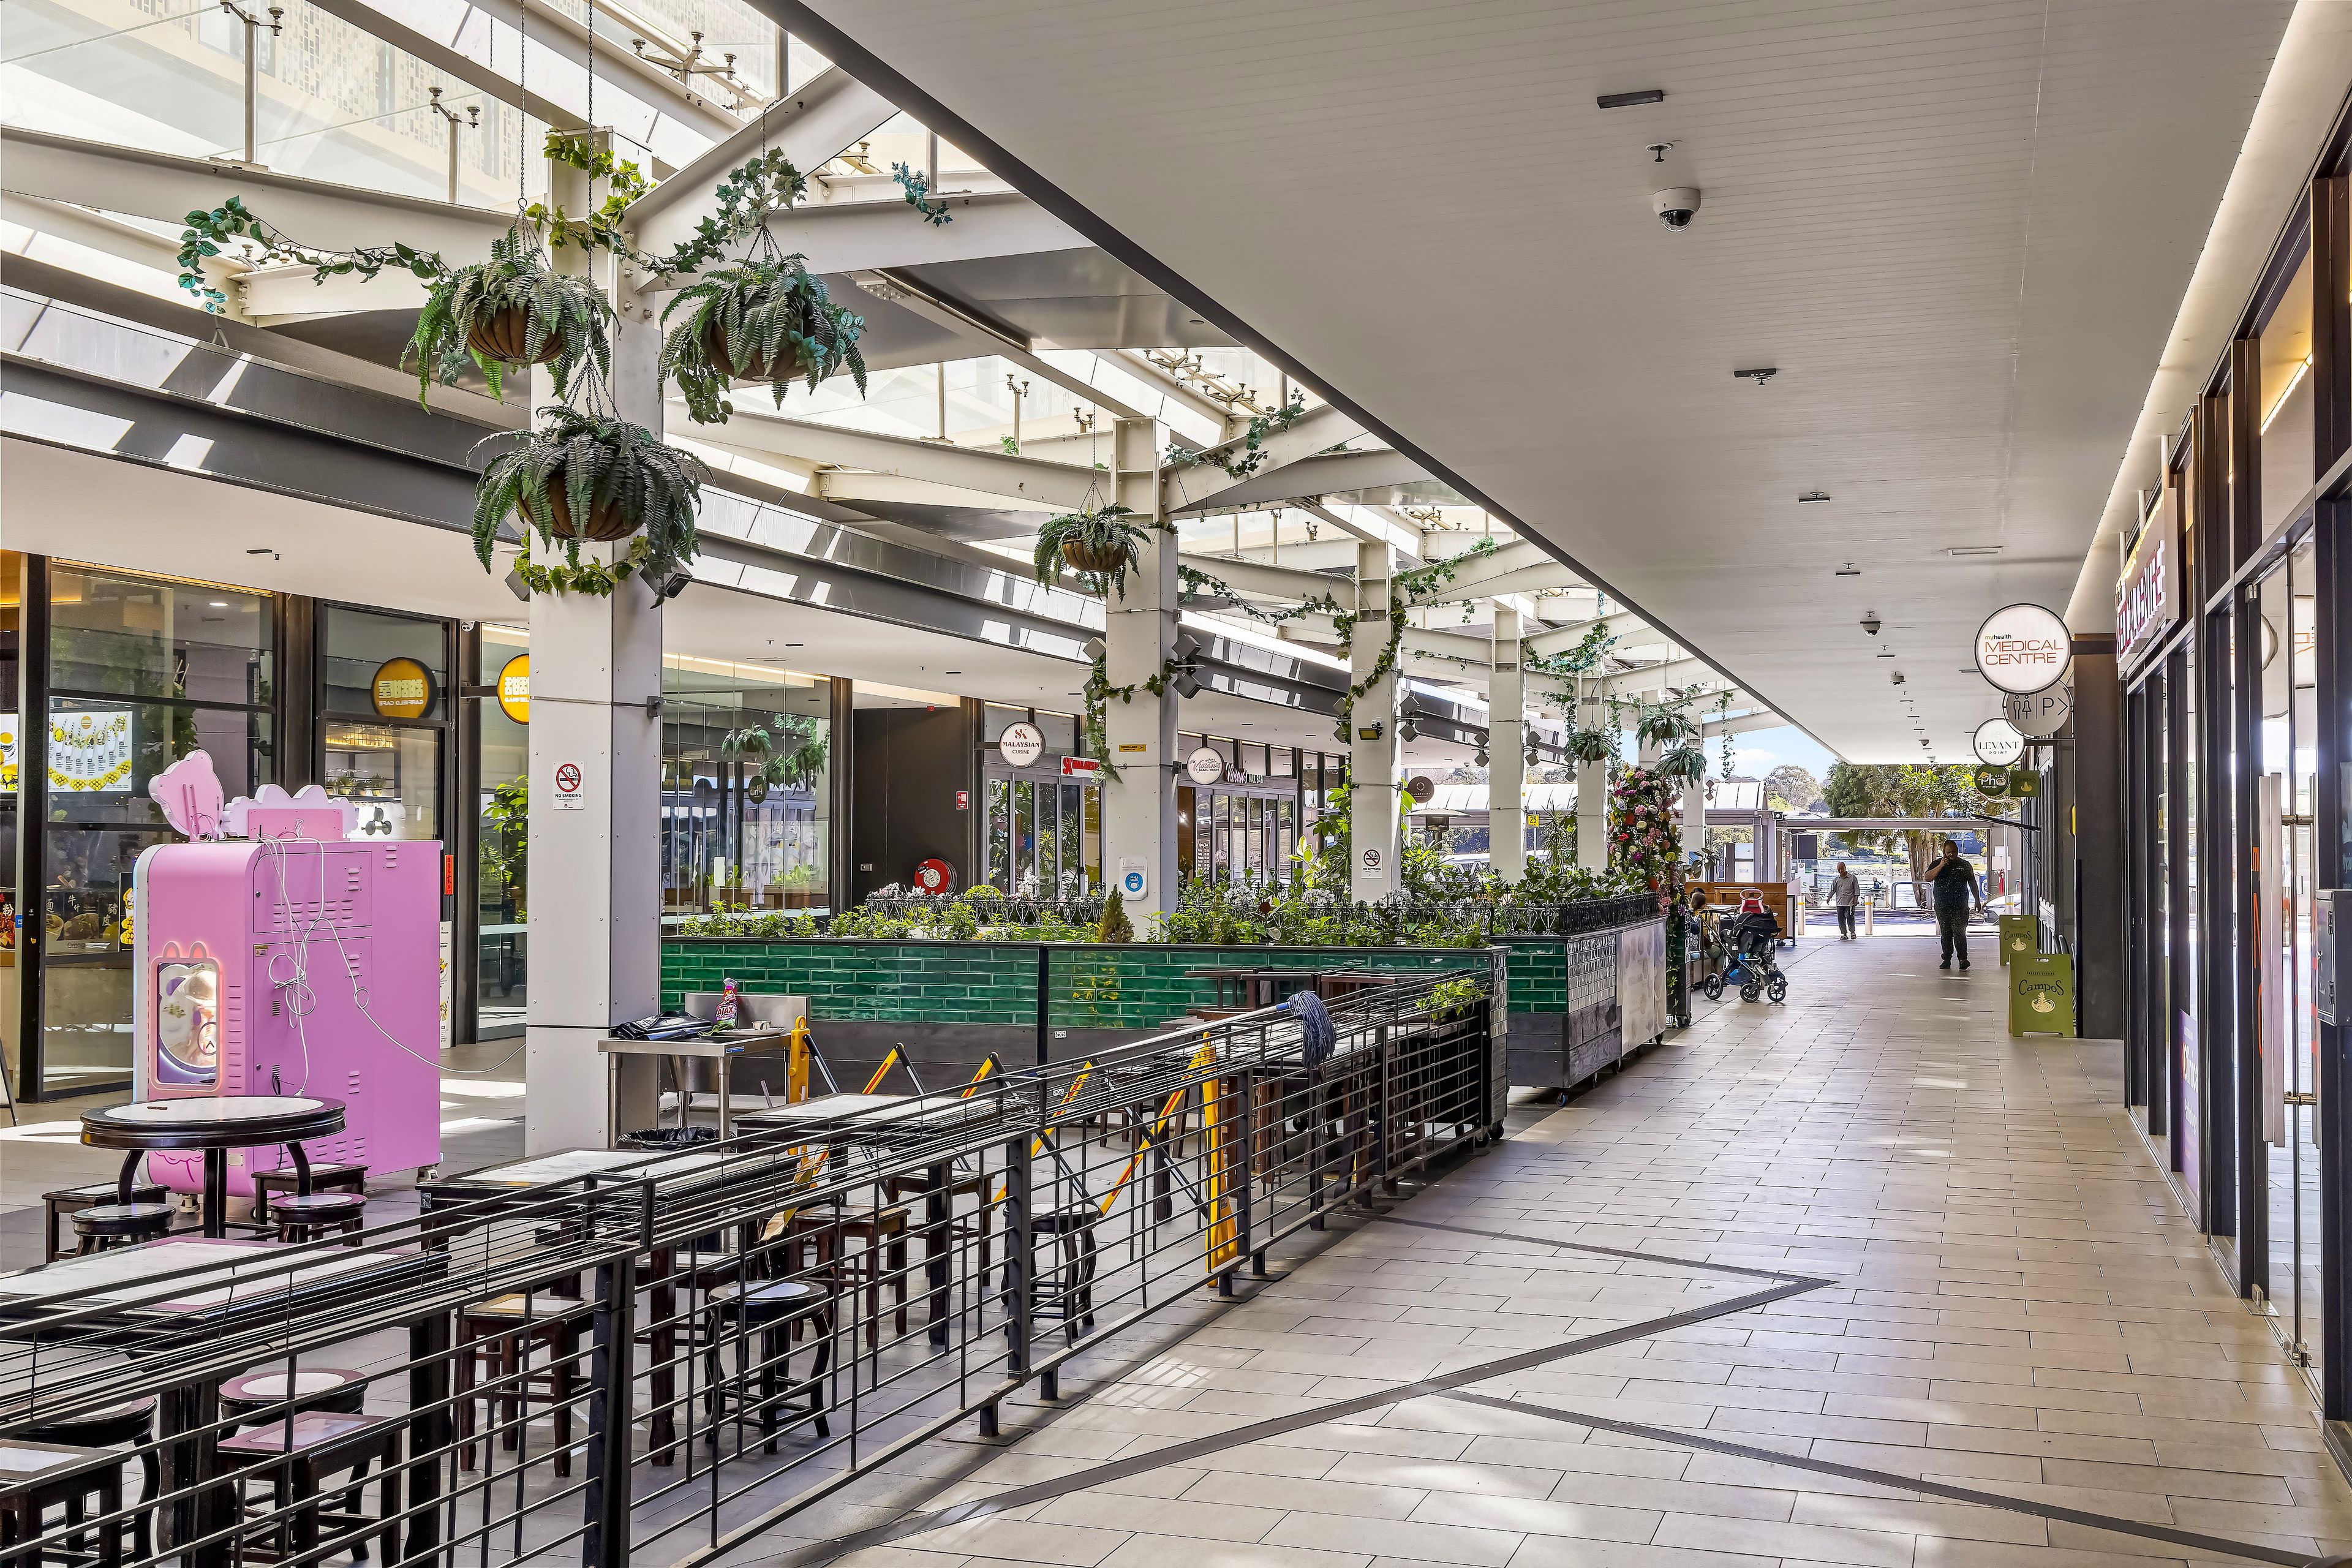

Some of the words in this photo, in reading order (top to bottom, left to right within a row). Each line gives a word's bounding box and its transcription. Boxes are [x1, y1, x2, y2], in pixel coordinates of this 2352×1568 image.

[1985, 639, 2064, 653] MEDICAL
[1985, 652, 2057, 665] CENTRE
[1979, 741, 2019, 750] LEVANT
[2004, 930, 2032, 941] Campos
[2018, 979, 2064, 996] Campos
[717, 1006, 734, 1016] AJAX
